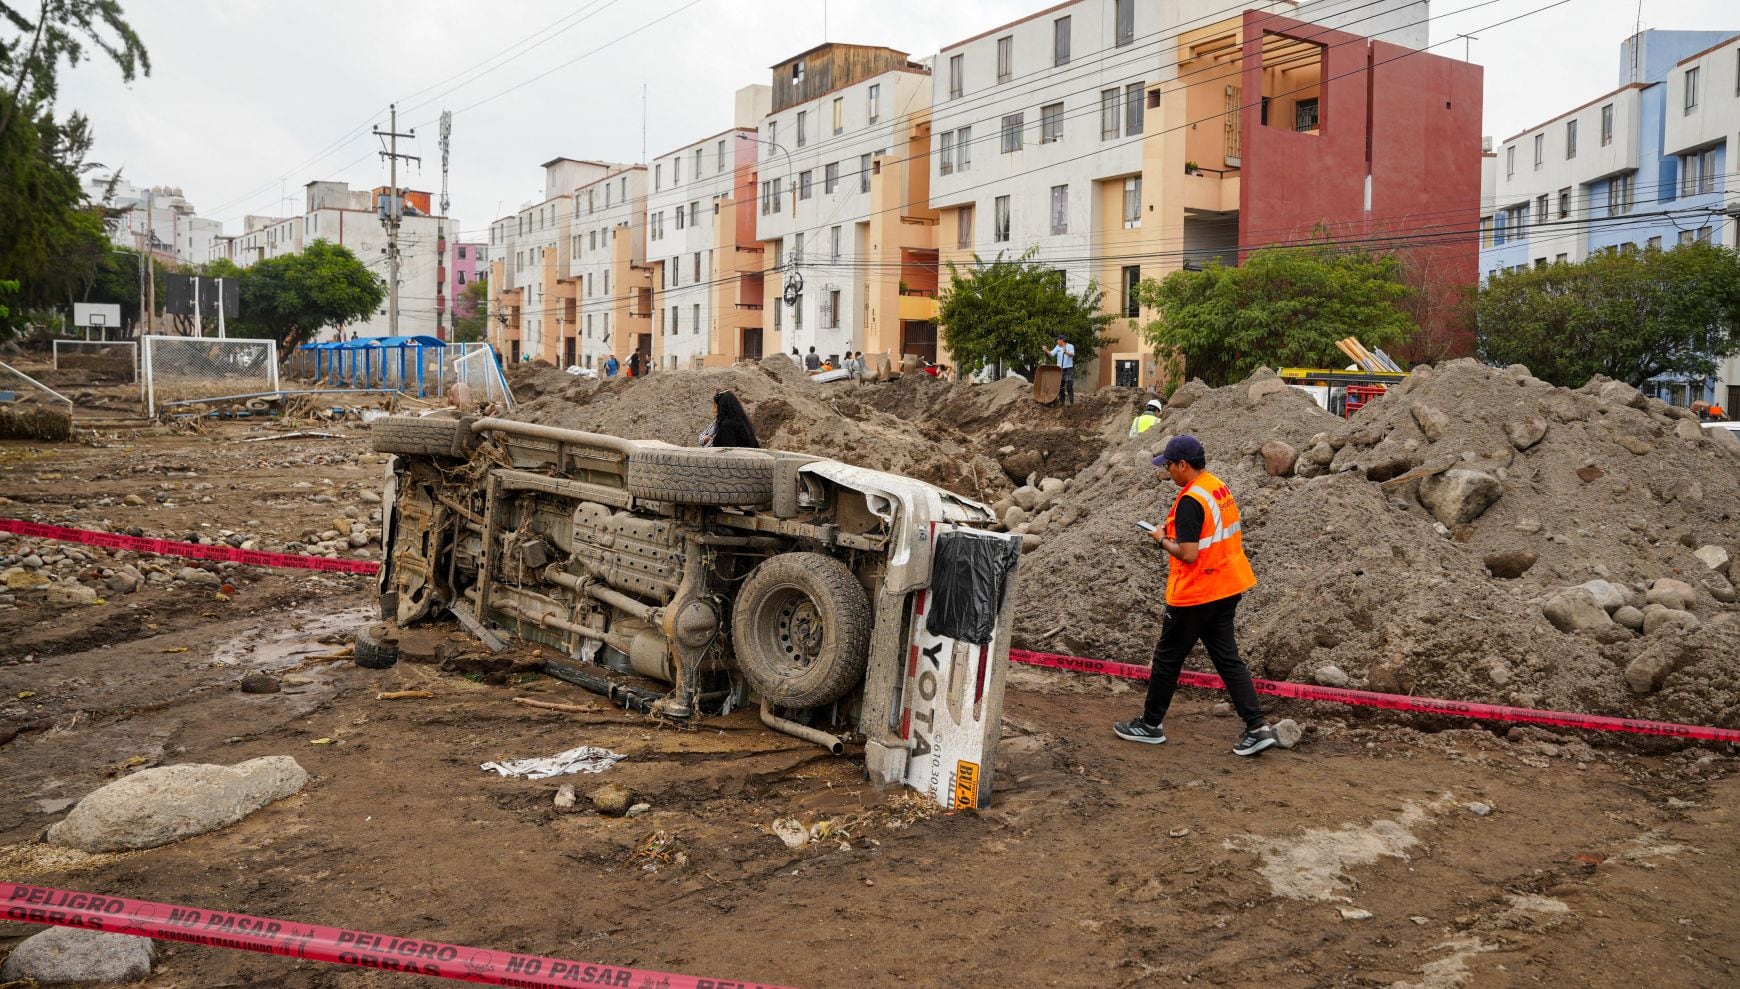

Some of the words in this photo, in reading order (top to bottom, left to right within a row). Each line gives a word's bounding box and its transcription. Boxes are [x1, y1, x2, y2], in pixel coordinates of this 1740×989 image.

[1056, 658, 1104, 670] OBRAS
[912, 642, 943, 758] YOTA
[1411, 700, 1469, 712] OBRAS
[1622, 722, 1689, 735] OBRAS
[8, 887, 124, 914] PELIGRO
[8, 907, 103, 928] OBRAS
[165, 908, 201, 928] NO
[204, 914, 282, 940] PASAR
[158, 930, 208, 944] PERSONAS
[210, 937, 273, 953] TRABAJANDO
[336, 931, 458, 961] PELIGRO
[338, 952, 441, 976] OBRAS
[505, 956, 542, 976] NO
[548, 962, 632, 988] PASAR
